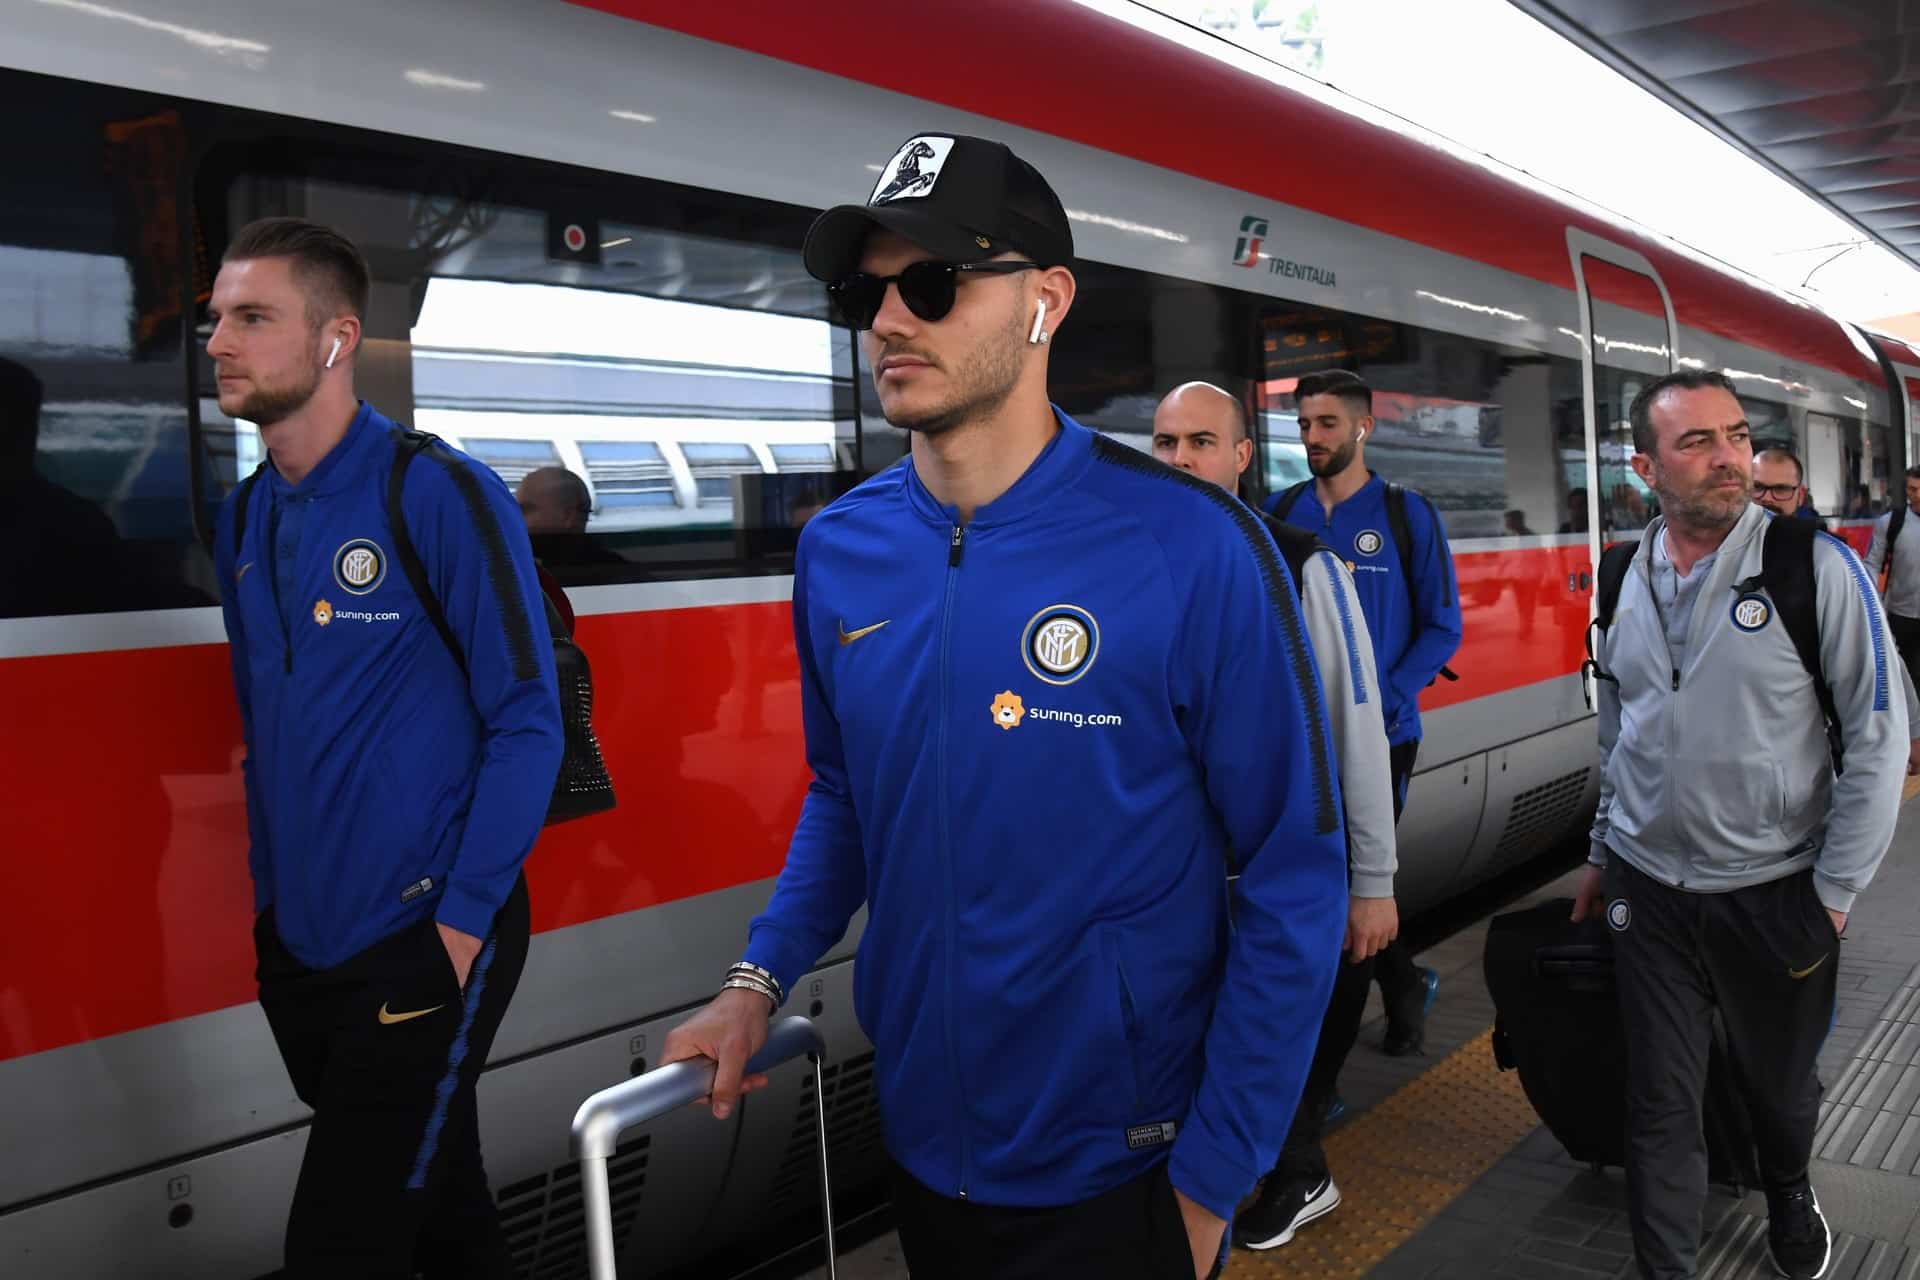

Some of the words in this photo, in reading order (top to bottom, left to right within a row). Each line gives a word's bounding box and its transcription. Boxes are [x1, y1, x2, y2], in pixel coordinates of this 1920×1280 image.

[1269, 258, 1337, 288] TRENITALIA
[335, 610, 400, 623] suning.com
[1030, 707, 1122, 728] suning.com
